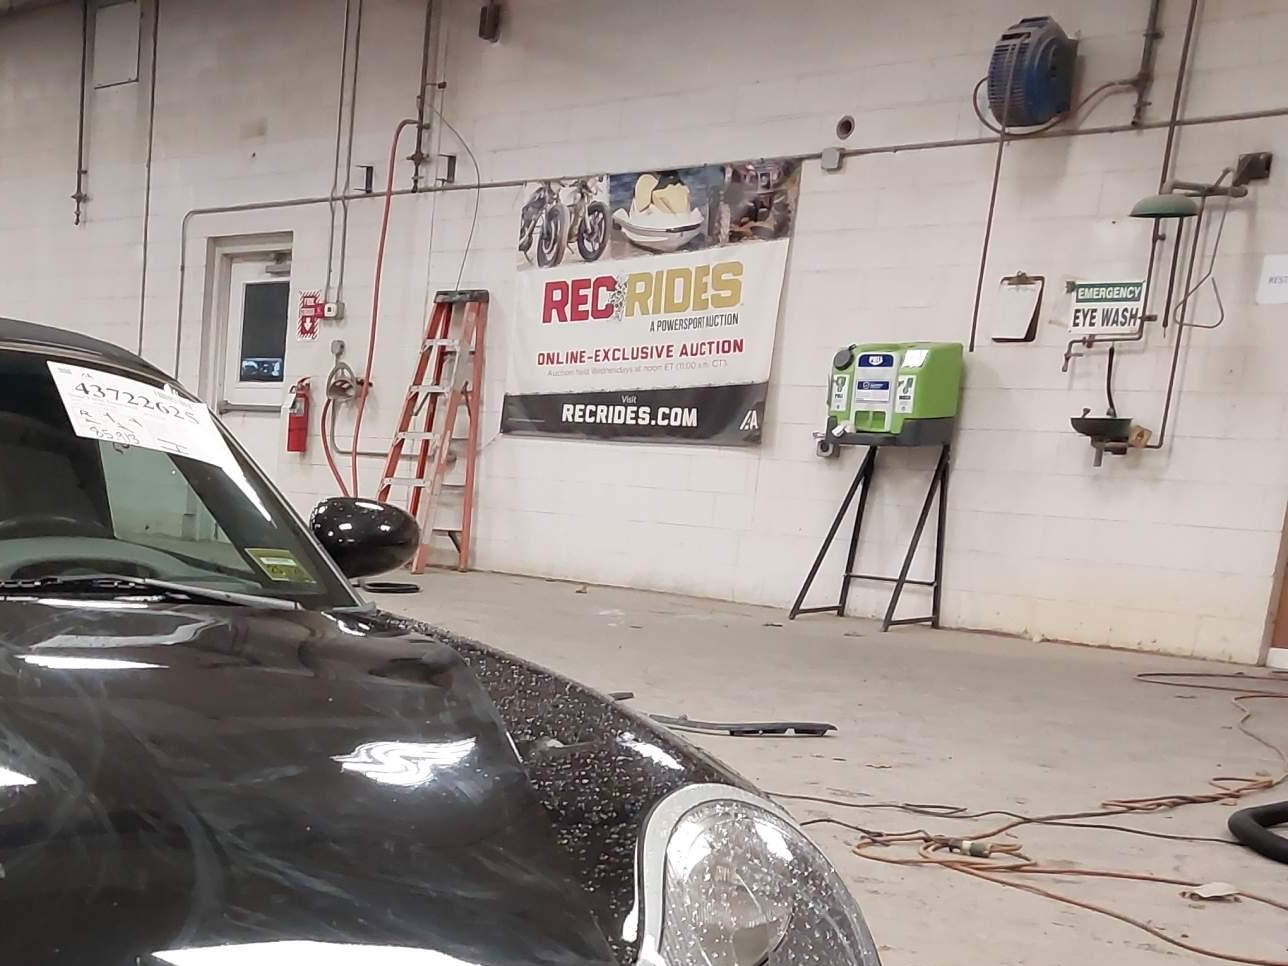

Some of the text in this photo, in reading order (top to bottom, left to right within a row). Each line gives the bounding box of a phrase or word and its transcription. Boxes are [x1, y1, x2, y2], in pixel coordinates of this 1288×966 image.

[542, 261, 744, 323] REC RIDES
[1078, 287, 1142, 299] EMERGENCY
[650, 313, 739, 332] A POWERSPORT AUCTION
[1072, 307, 1139, 327] EYE WASH
[537, 339, 744, 366] ONLINE-EXCLUSIVE AUCTION
[74, 382, 200, 425] 43722625
[622, 395, 638, 404] Visit
[562, 404, 698, 427] RECRIDES.COM
